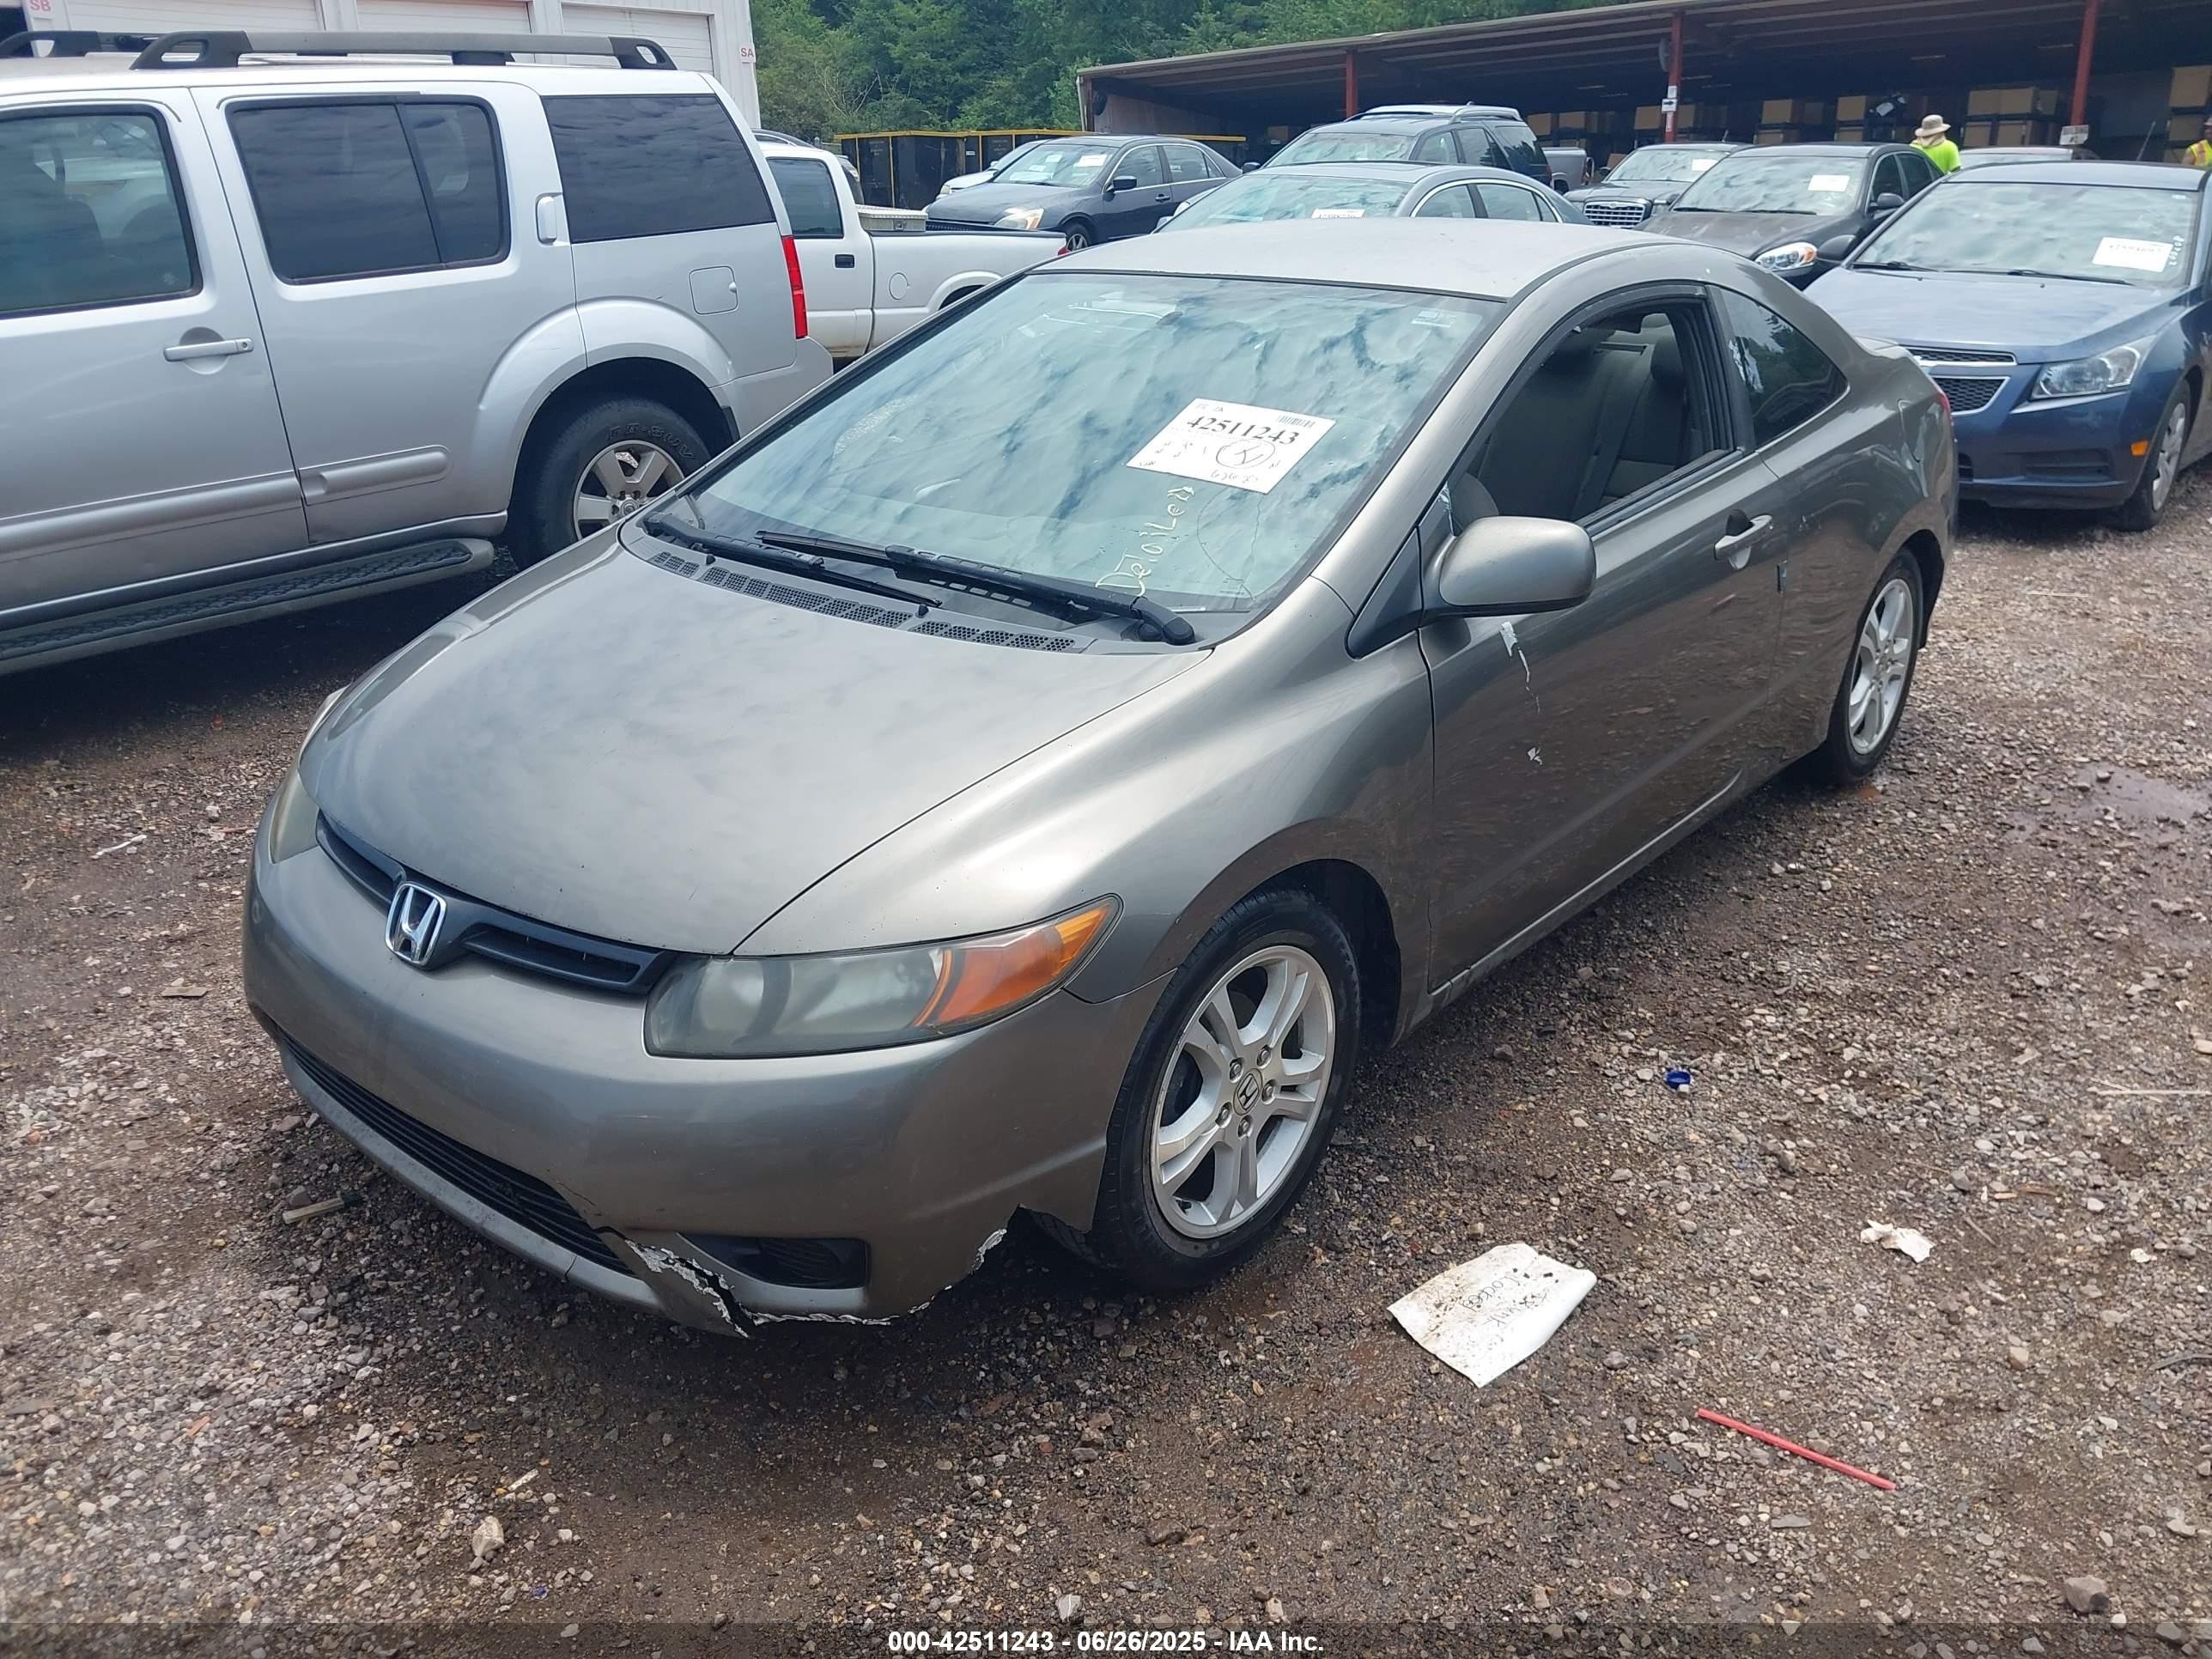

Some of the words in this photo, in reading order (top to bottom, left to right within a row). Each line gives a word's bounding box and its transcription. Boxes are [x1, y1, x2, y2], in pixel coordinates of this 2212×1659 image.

[30, 0, 51, 11] SB
[740, 47, 754, 58] SA
[1187, 416, 1299, 445] 42511243
